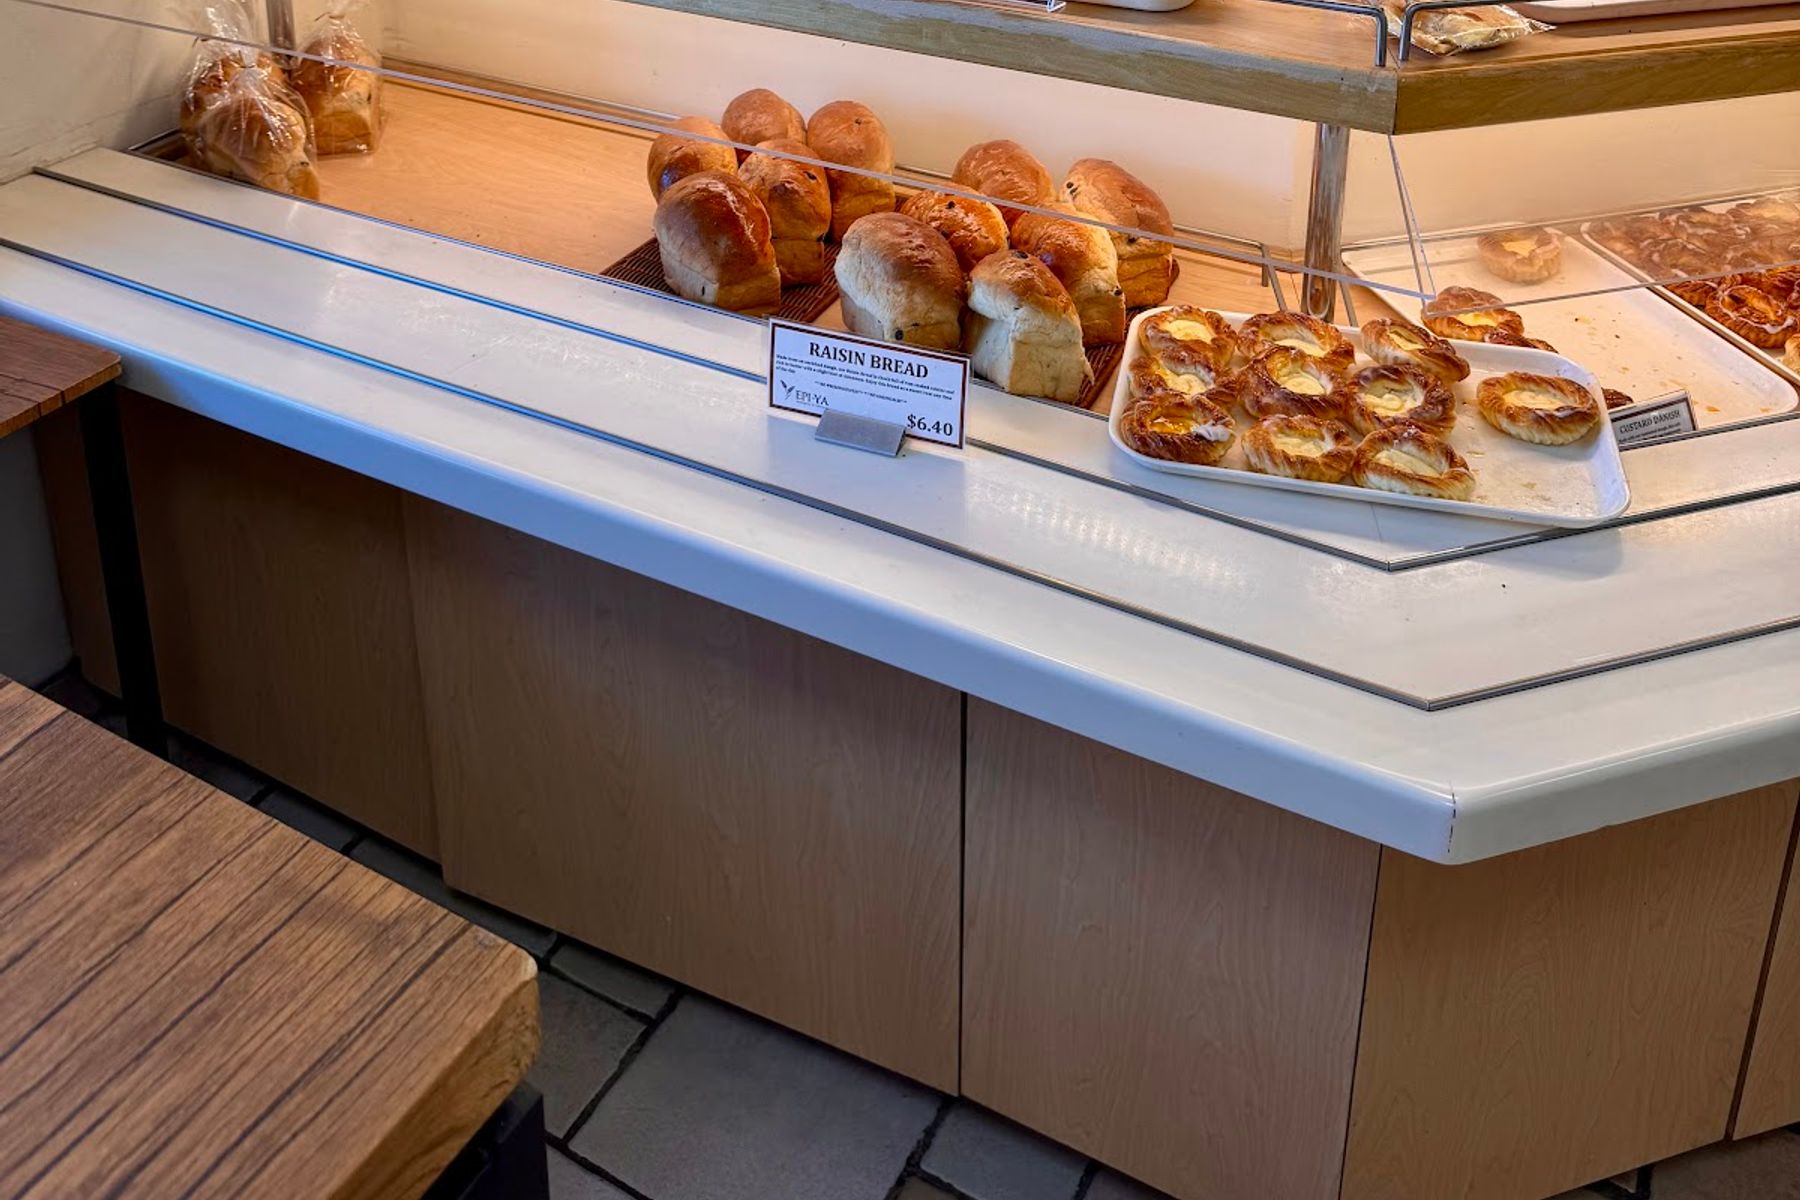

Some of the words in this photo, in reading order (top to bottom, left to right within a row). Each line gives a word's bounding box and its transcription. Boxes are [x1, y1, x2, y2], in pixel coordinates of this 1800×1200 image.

[809, 341, 866, 366] RAISIN
[870, 354, 929, 378] BREAD
[795, 389, 829, 406] EPI-YA
[907, 413, 953, 437] $6.40
[1620, 418, 1653, 434] CUSTARD
[1653, 410, 1681, 425] DANISH
